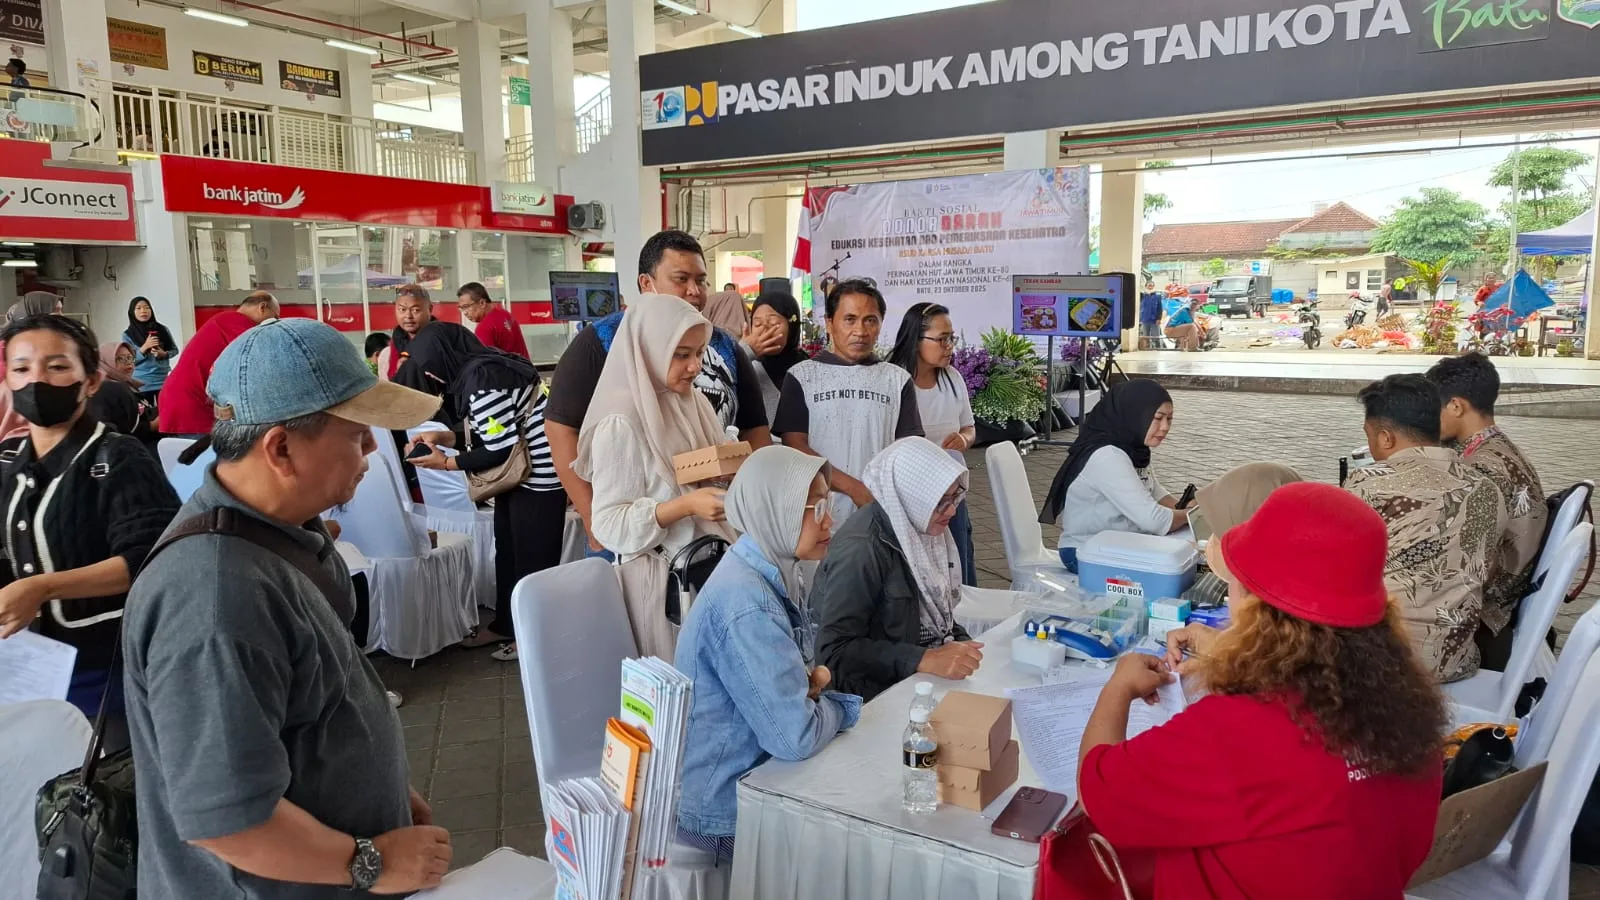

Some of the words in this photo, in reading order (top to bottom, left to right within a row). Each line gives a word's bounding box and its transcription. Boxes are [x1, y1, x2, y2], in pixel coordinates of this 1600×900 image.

[1422, 0, 1548, 49] Batu
[718, 73, 829, 117] PASAR
[834, 56, 953, 104] INDUK
[958, 31, 1129, 89] AMONG
[1134, 17, 1250, 67] TANI
[1255, 0, 1412, 53] KOTA
[211, 61, 260, 77] BERKAH
[327, 70, 335, 81] 2
[20, 187, 117, 209] JConnect
[203, 182, 243, 201] bank
[243, 187, 283, 206] jatim
[502, 192, 518, 202] bank
[519, 193, 536, 205] jatim
[904, 207, 936, 217] BAKTI
[939, 203, 980, 215] SOSIAL
[831, 238, 866, 250] EDUKASI
[868, 235, 917, 249] KESEHATAN
[1008, 226, 1066, 241] KESEHATAN
[919, 260, 942, 268] DALAM
[944, 259, 972, 267] RANGKA
[887, 269, 927, 278] PERINGATAN
[929, 268, 942, 277] HUT
[943, 267, 963, 275] JAWA
[966, 266, 986, 275] TIMUR
[884, 279, 899, 287] DAN
[900, 278, 915, 286] HARI
[917, 276, 955, 285] KESEHATAN
[956, 275, 991, 284] NASIONAL
[943, 286, 969, 294] OKTOBER
[971, 285, 987, 293] 2025
[814, 390, 836, 403] BEST
[839, 389, 856, 399] NOT
[859, 390, 891, 404] BETTER
[1107, 585, 1125, 594] COOL
[1128, 587, 1142, 596] BOX
